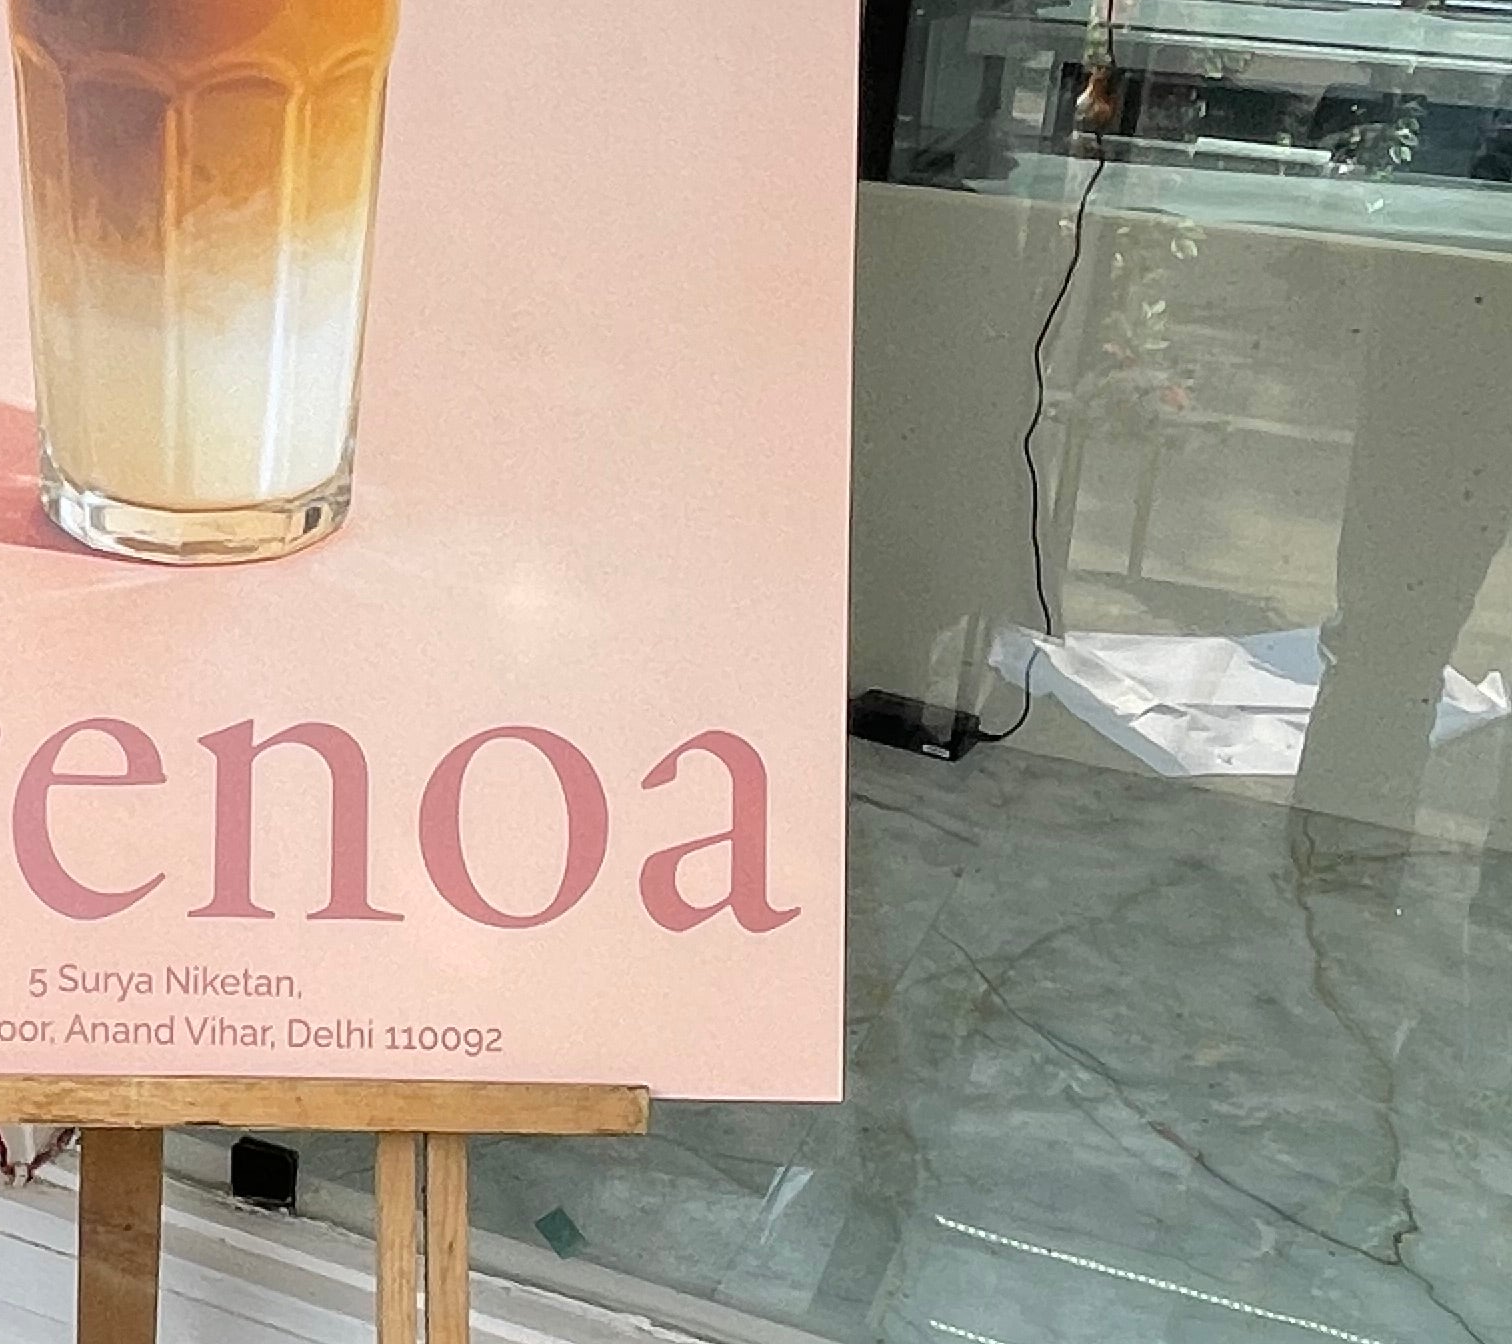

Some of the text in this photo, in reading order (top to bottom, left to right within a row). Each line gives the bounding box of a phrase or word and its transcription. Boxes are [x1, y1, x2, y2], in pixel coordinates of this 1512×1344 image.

[28, 963, 303, 1003] 5 Surya Niketan,
[64, 1014, 176, 1047] Anand
[183, 1015, 276, 1050] Vihar,
[287, 1018, 374, 1051] Delhi
[384, 1025, 504, 1058] 110092
